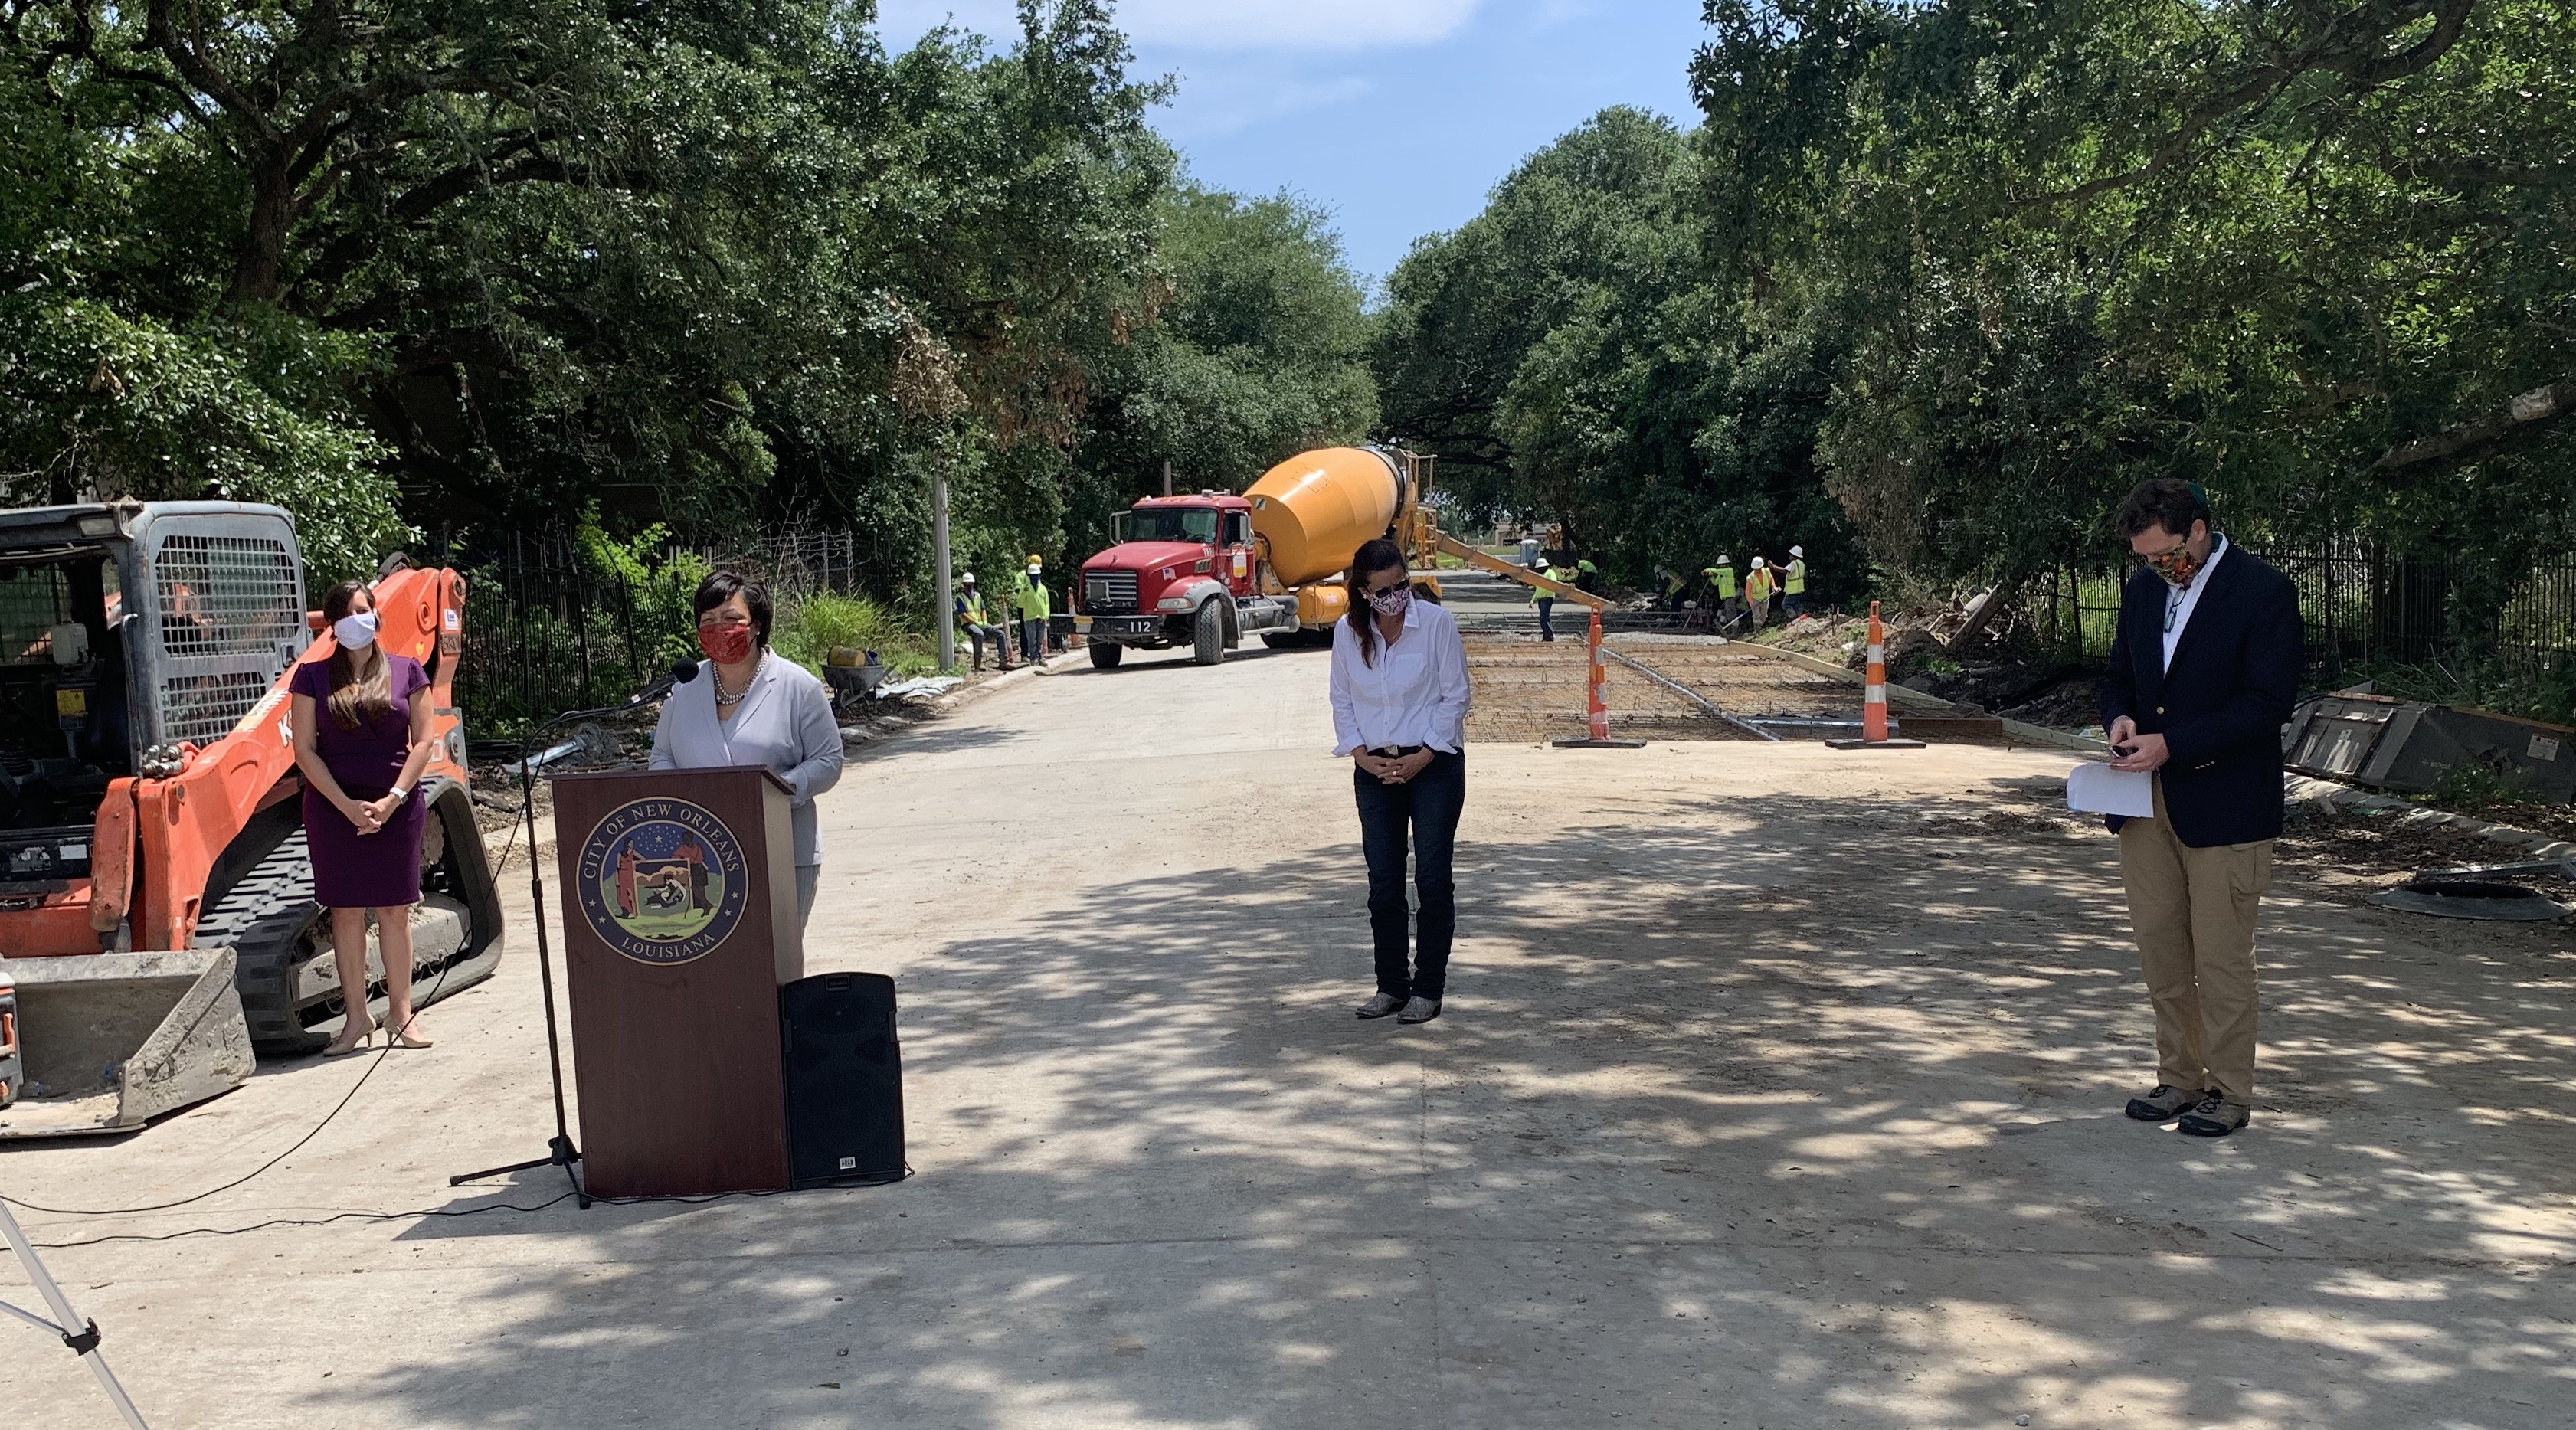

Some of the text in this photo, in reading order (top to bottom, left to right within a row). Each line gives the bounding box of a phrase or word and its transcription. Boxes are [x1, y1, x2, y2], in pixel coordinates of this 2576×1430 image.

[1130, 621, 1151, 633] 112
[584, 803, 740, 879] CITY OF NEW ORLEANS
[621, 933, 715, 958] LOUISIANA
